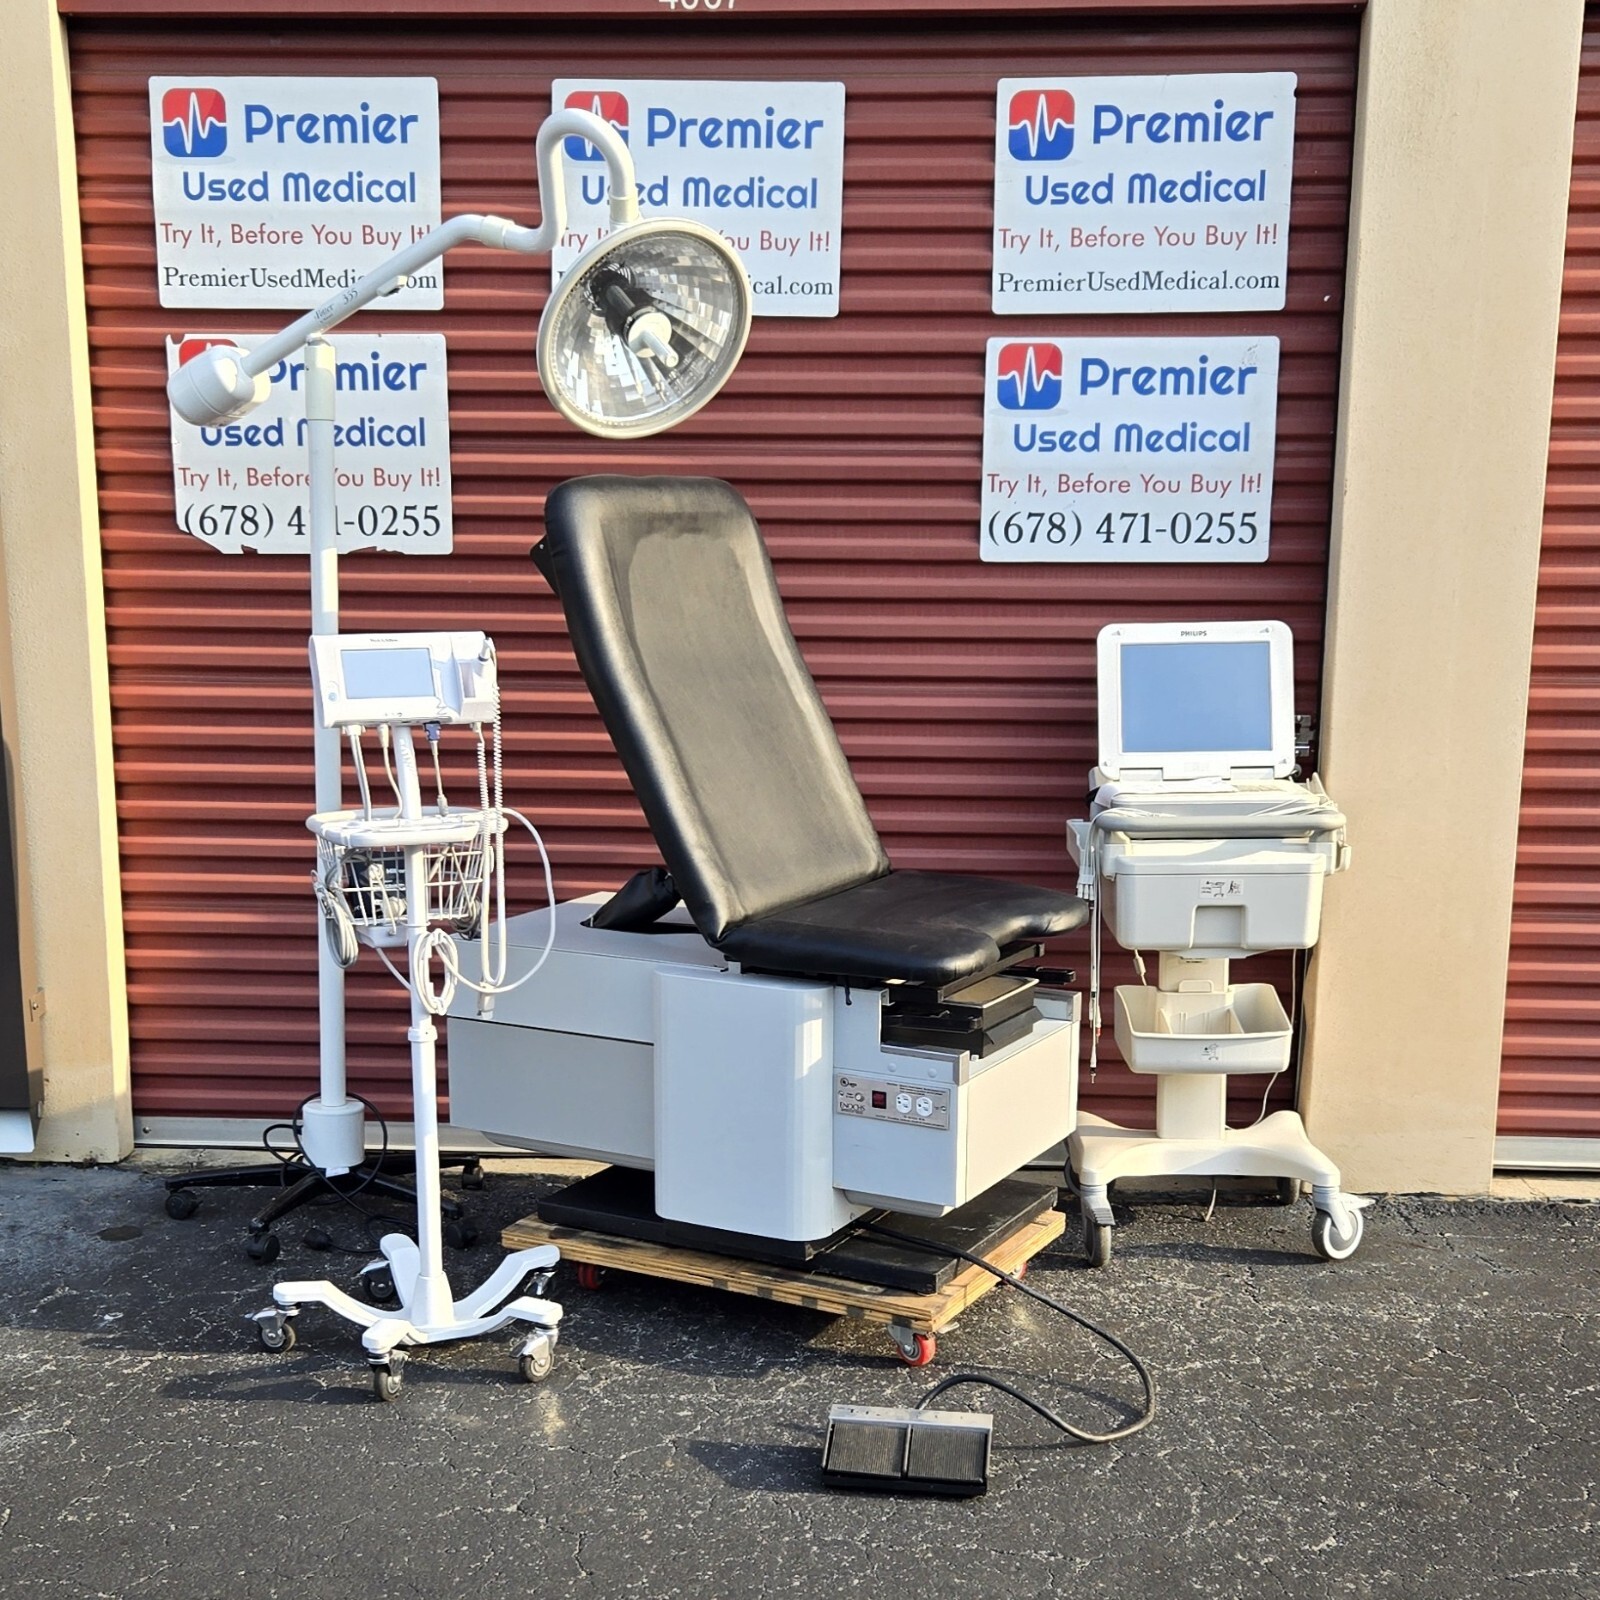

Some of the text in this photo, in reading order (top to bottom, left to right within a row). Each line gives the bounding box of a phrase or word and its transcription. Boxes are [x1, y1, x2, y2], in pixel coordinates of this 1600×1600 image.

[244, 102, 419, 144] Premier
[647, 106, 824, 149] Premier
[1093, 99, 1274, 144] Premier
[183, 171, 416, 203] Used Medical
[581, 175, 818, 209] Ued Medical
[1025, 169, 1266, 205] Used Medical
[160, 223, 192, 249] Try
[200, 223, 221, 248] It,
[231, 223, 304, 245] Before
[311, 224, 352, 246] You
[362, 224, 402, 251] Buy
[760, 230, 801, 257] Buy
[809, 231, 830, 252] It!
[999, 223, 1278, 254] Try It, Before You Buy It!
[163, 267, 437, 289] PremierUsedMediom
[998, 270, 1280, 292] PremierUsedMedical.com
[1080, 355, 1257, 396] Premier
[1014, 421, 1250, 452] Used Medical
[178, 467, 209, 492] Try
[217, 468, 238, 491] It,
[334, 467, 364, 487] ou
[374, 468, 412, 492] Buy
[421, 468, 441, 487] It!
[987, 473, 1262, 498] Try It, Before You Buy It!
[184, 503, 274, 539] (678)
[988, 510, 1257, 546] (678) 471-0255
